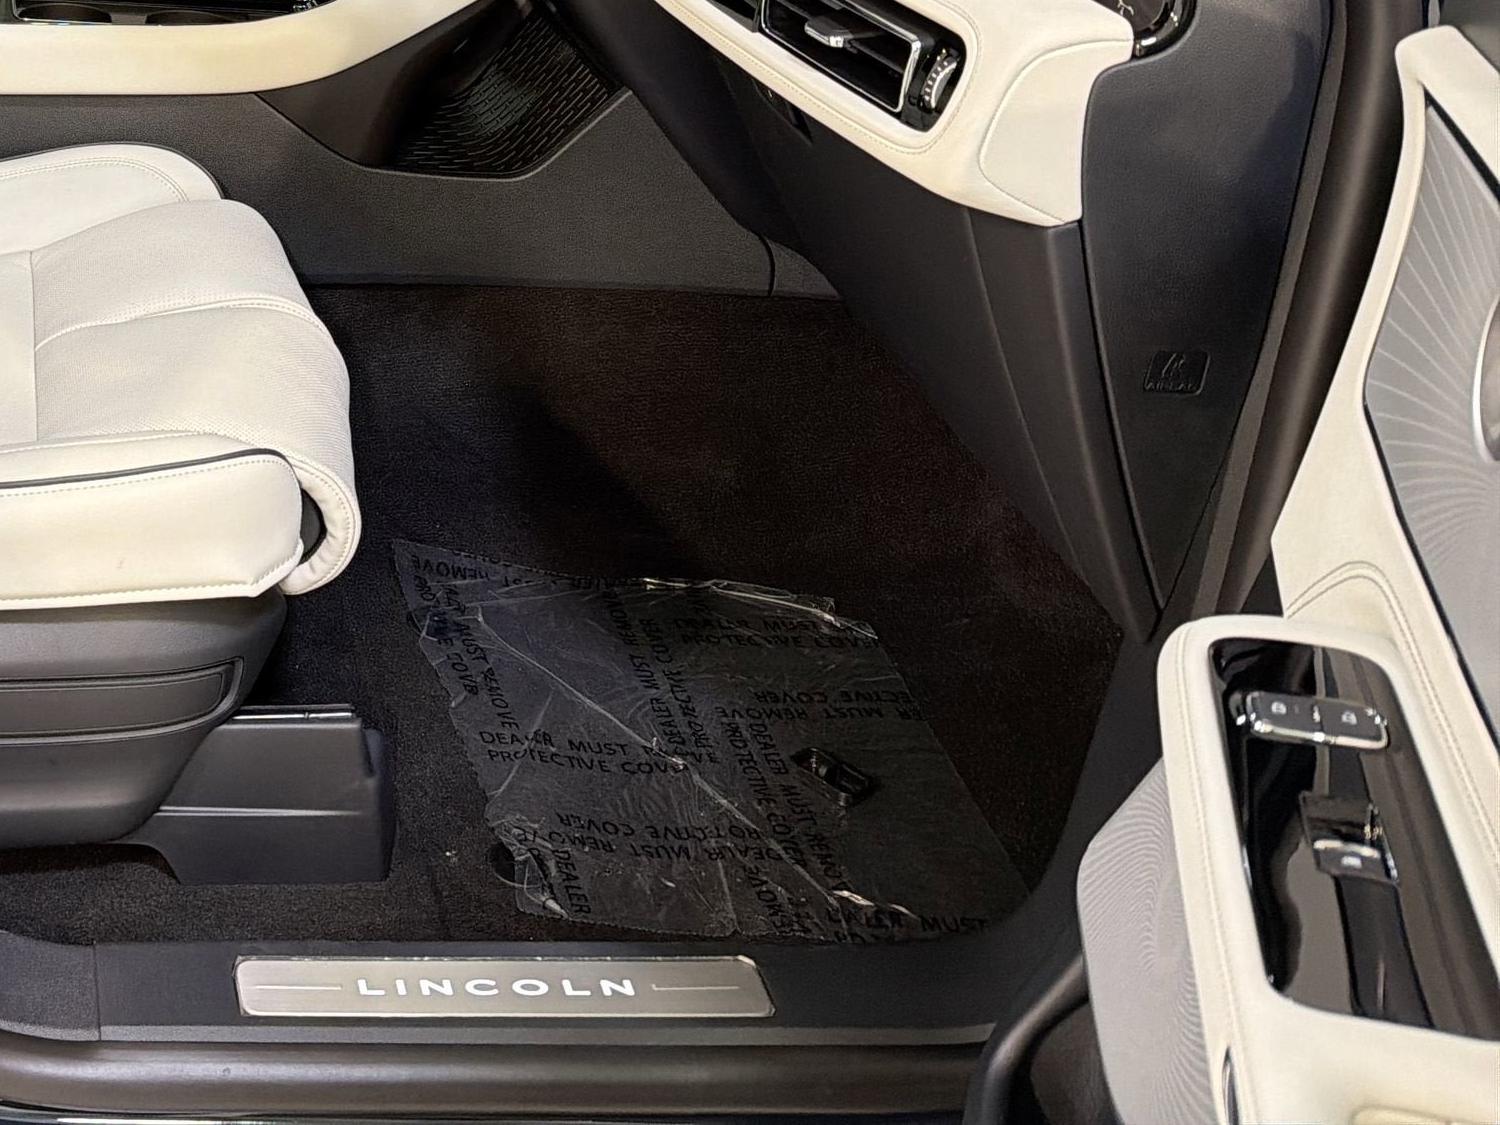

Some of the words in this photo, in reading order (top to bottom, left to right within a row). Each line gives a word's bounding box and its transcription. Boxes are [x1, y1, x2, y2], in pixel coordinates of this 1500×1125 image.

[628, 653, 661, 691] MUST
[567, 739, 628, 755] MUST
[749, 723, 789, 775] DEALER
[554, 810, 636, 837] COVER
[630, 842, 692, 861] MUST
[551, 848, 592, 915] DEALER
[356, 978, 636, 997] LINCOLN
